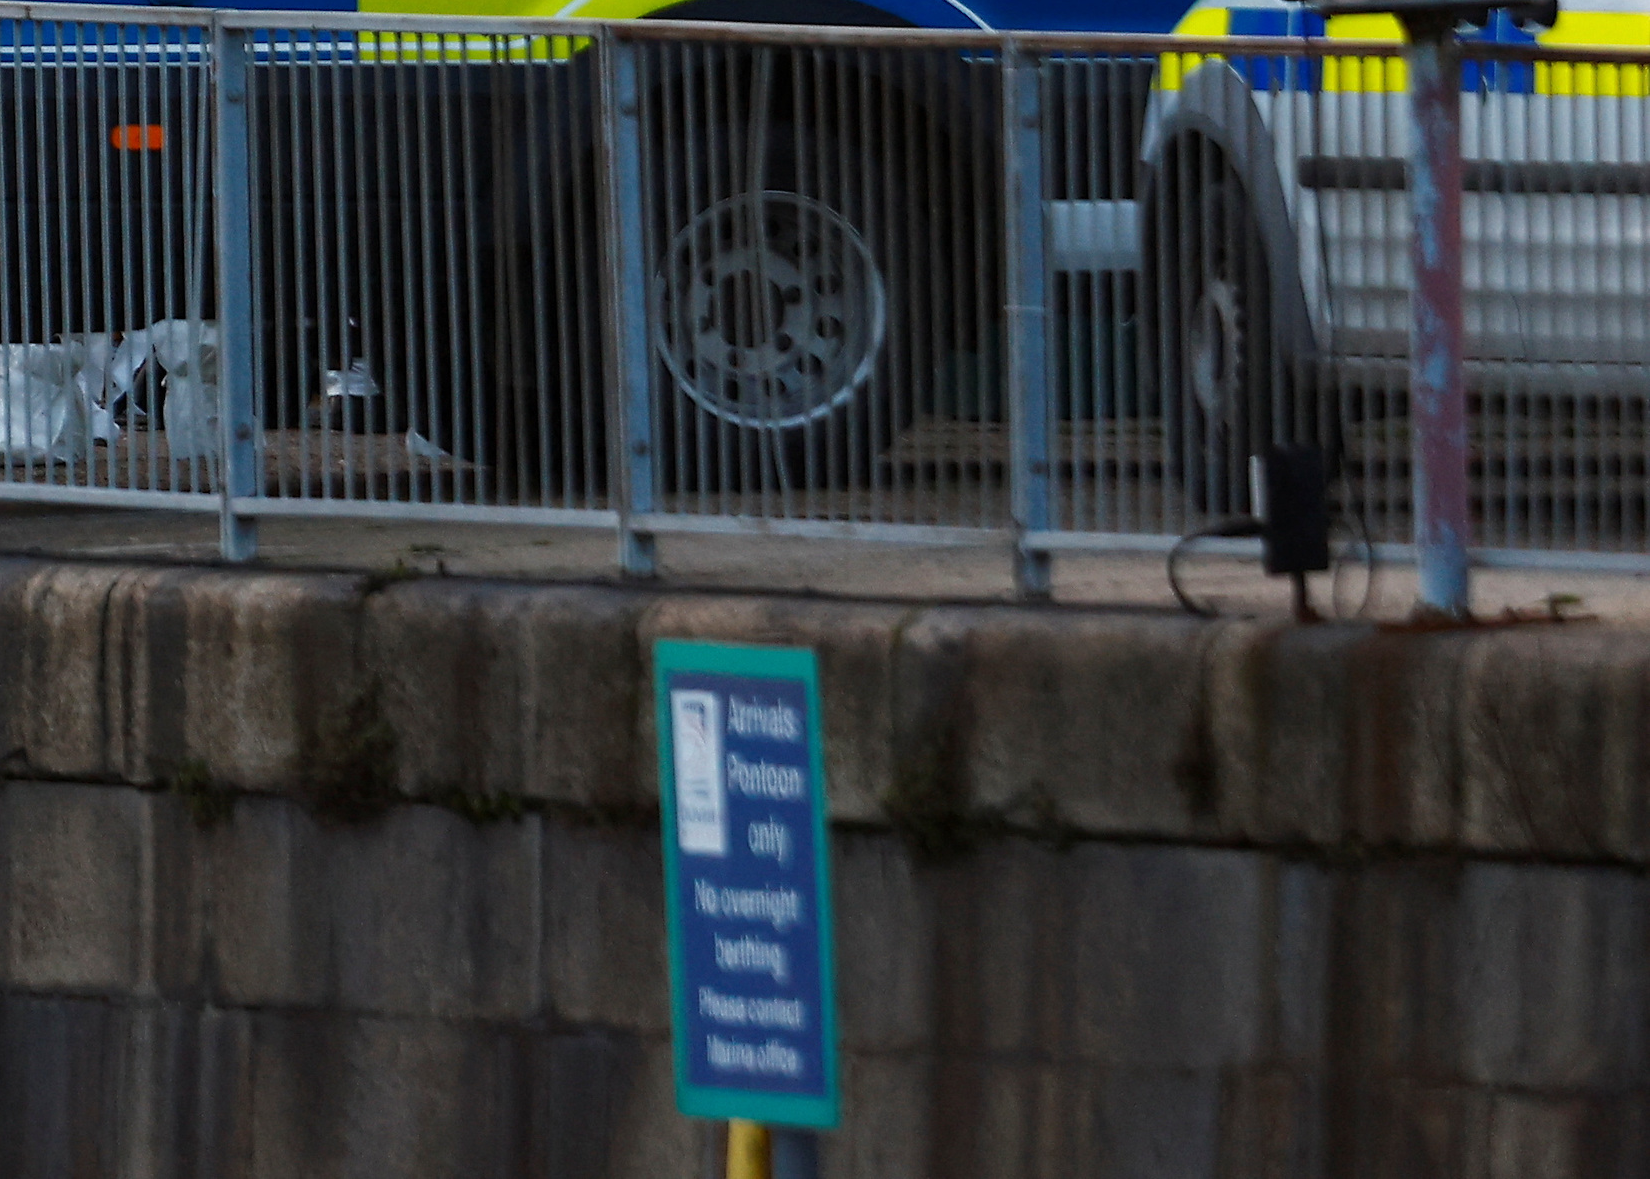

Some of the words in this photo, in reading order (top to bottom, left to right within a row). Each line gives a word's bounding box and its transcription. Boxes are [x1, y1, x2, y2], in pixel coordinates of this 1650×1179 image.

[727, 694, 801, 740] Arrivals
[727, 752, 802, 799] Pontoon
[748, 815, 786, 863] only
[694, 877, 717, 915] No
[720, 882, 800, 931] overnight
[714, 931, 785, 983] berthing
